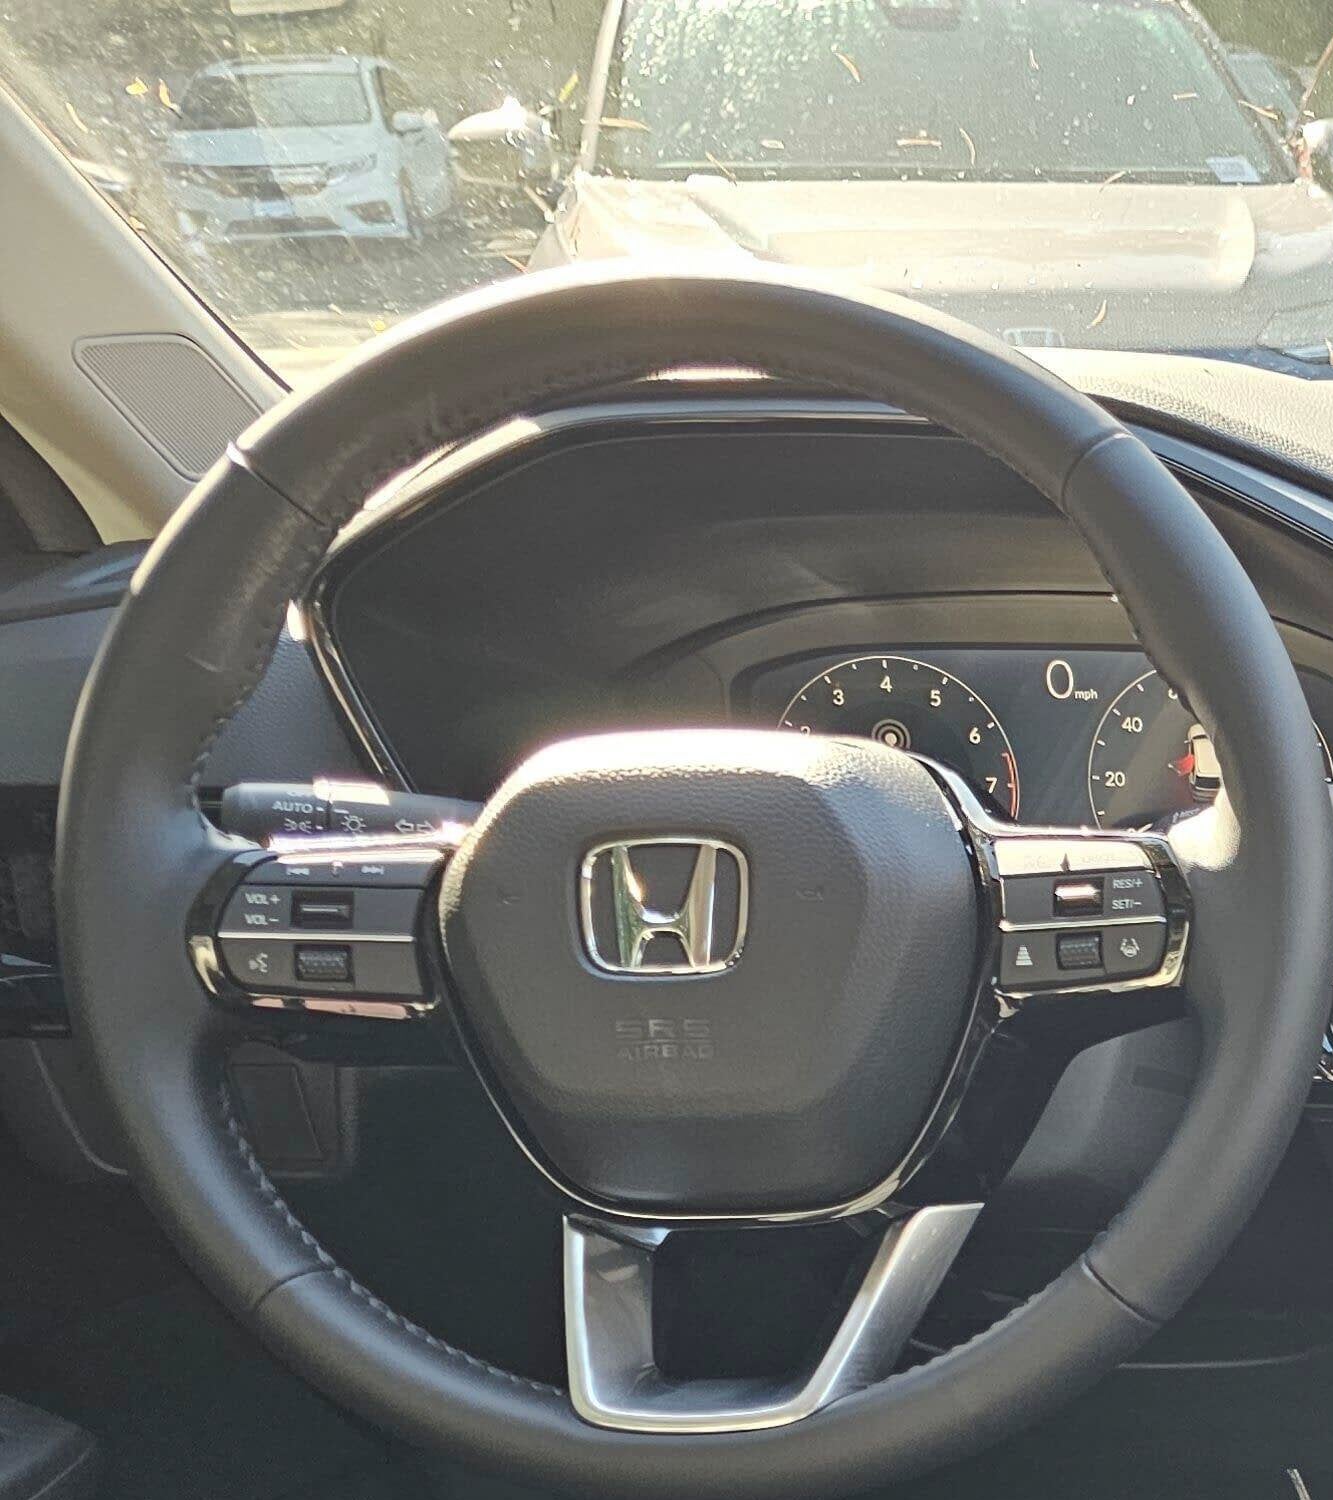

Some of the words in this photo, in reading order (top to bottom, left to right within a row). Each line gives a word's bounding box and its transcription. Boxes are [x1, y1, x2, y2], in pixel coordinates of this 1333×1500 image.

[880, 675, 893, 693] 4
[1045, 660, 1074, 700] 0
[1075, 688, 1098, 701] mph
[832, 689, 845, 706] 3
[930, 690, 942, 707] 5
[1121, 716, 1143, 734] 40
[968, 727, 981, 745] 6
[985, 776, 998, 793] 7
[1104, 771, 1126, 788] 20
[271, 800, 314, 814] AUTO
